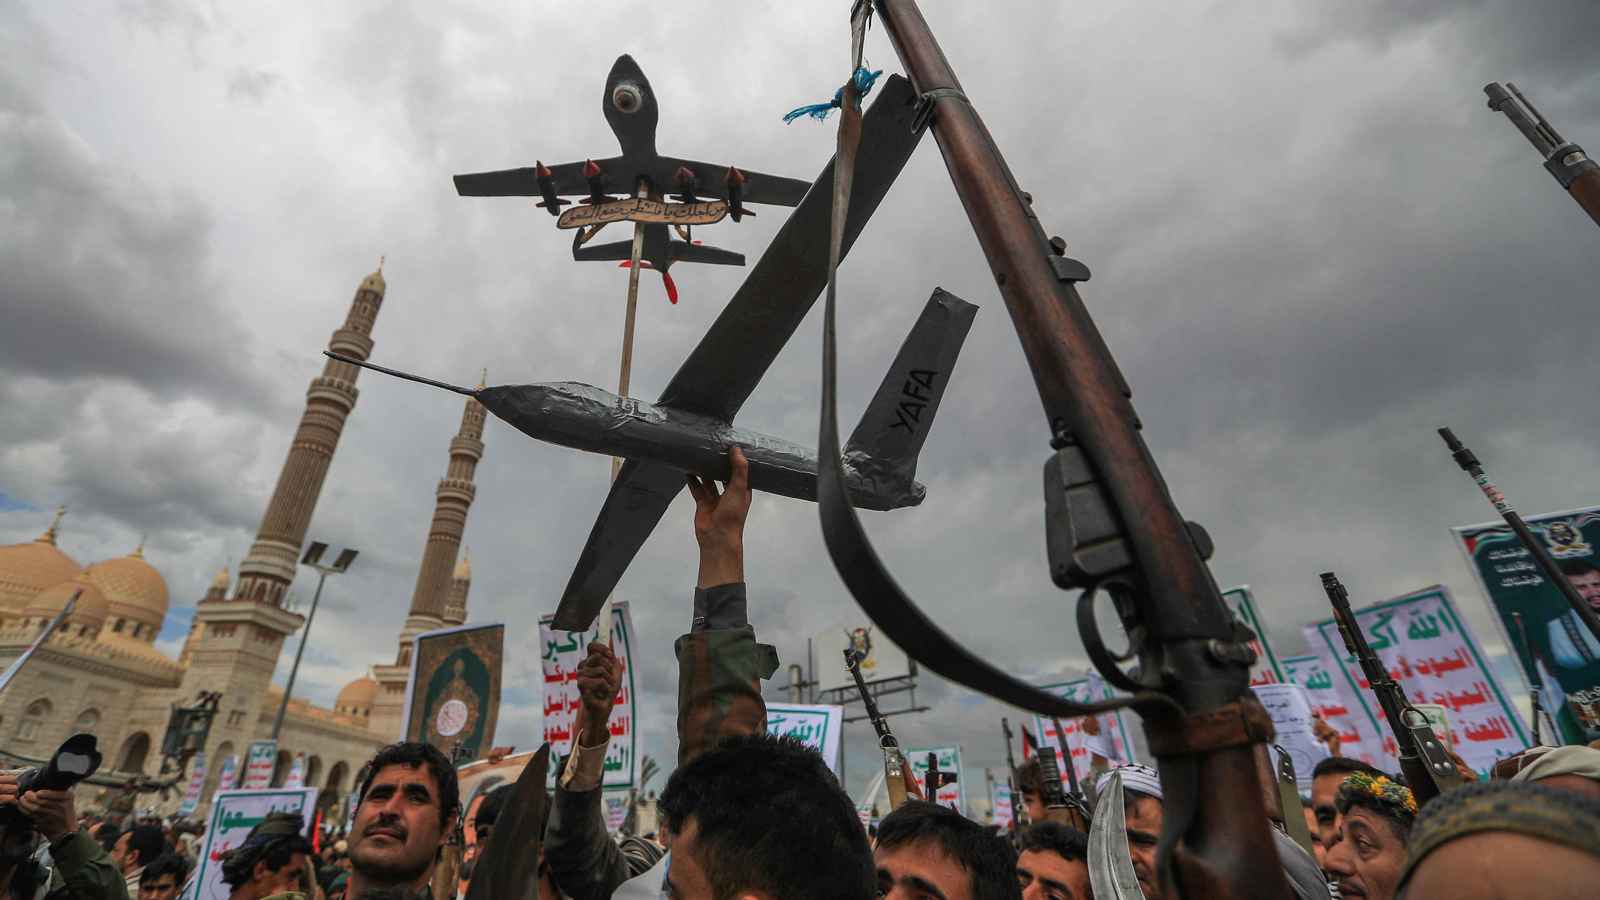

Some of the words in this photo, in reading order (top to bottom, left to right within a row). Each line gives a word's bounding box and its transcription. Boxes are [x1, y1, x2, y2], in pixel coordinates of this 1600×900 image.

[888, 369, 938, 434] YAFA
[1407, 607, 1454, 641] الله
[1415, 646, 1475, 681] الموت
[1460, 715, 1515, 743] اللعنة
